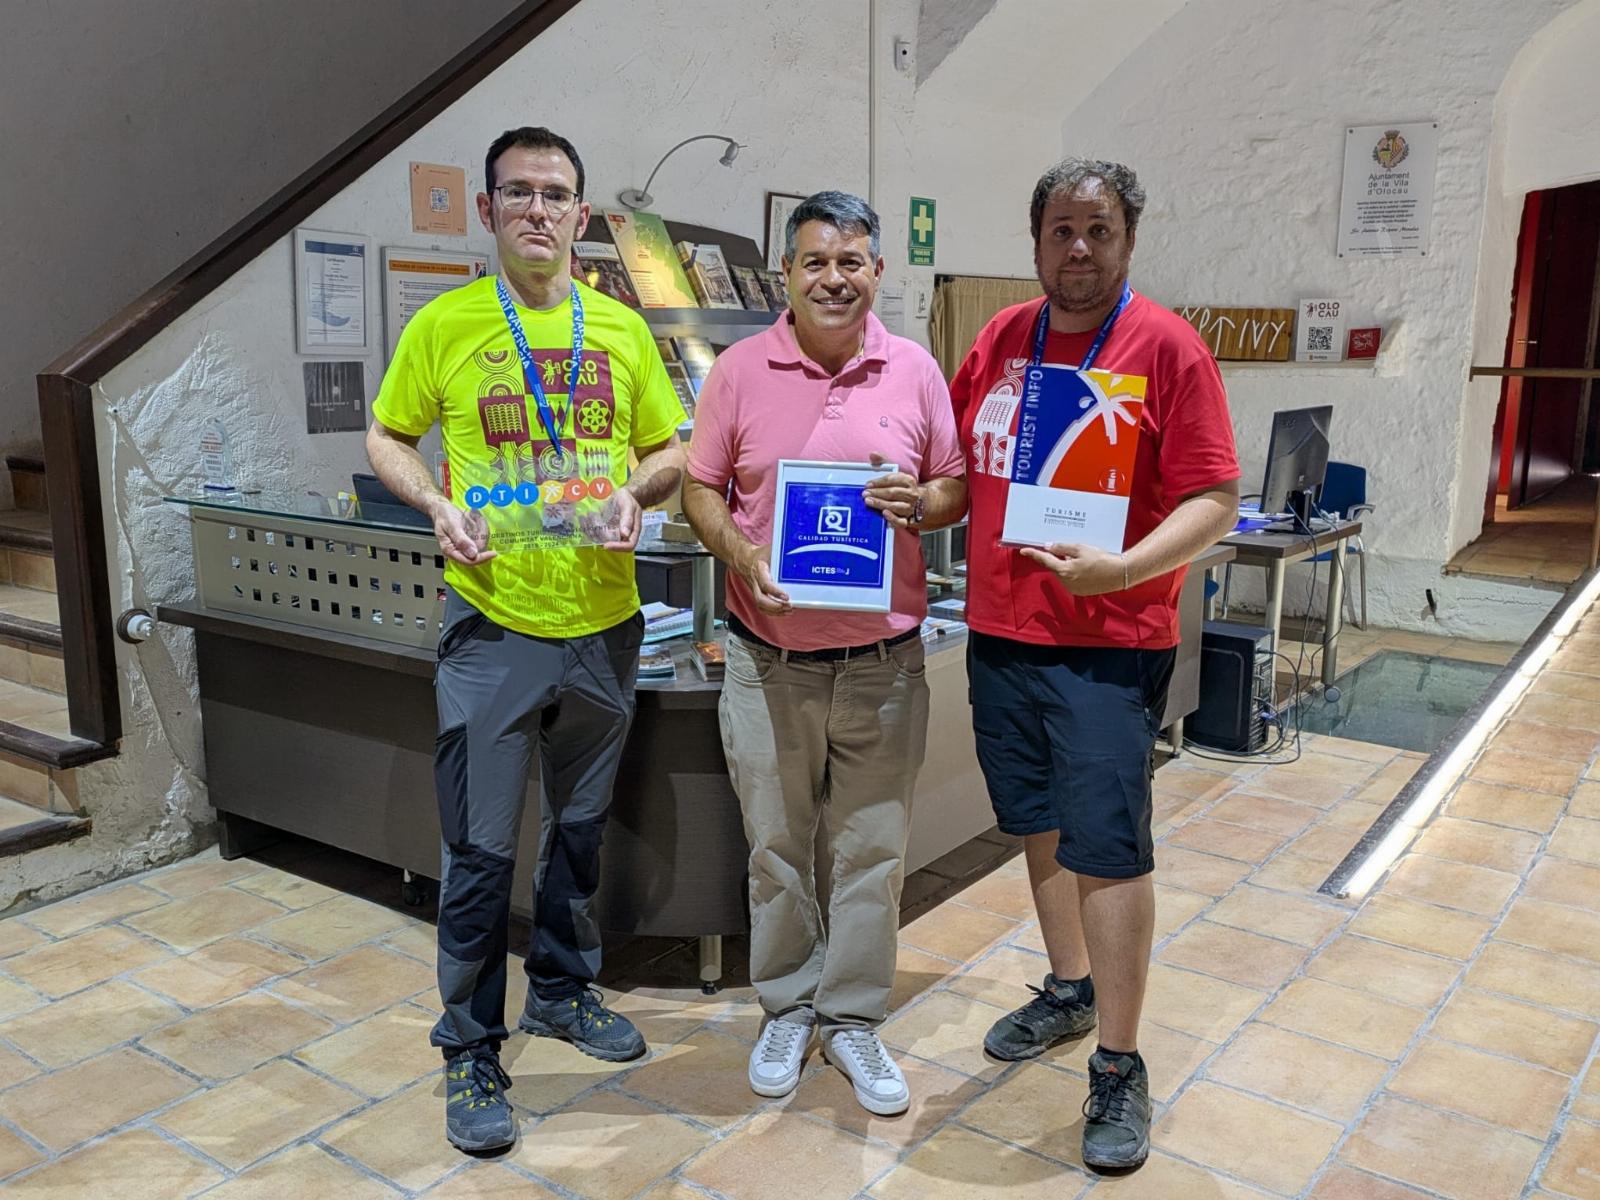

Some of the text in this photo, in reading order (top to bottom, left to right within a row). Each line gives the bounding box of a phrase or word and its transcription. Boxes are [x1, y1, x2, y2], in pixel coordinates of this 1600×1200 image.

[1368, 172, 1410, 181] Ajuntament
[1394, 179, 1408, 187] Vila
[1367, 188, 1409, 196] d'Olocau
[1318, 302, 1340, 310] OLO
[1318, 310, 1339, 318] CAU
[1025, 369, 1044, 409] INFO
[1015, 411, 1038, 481] TOURIST
[1045, 507, 1088, 518] TURISME
